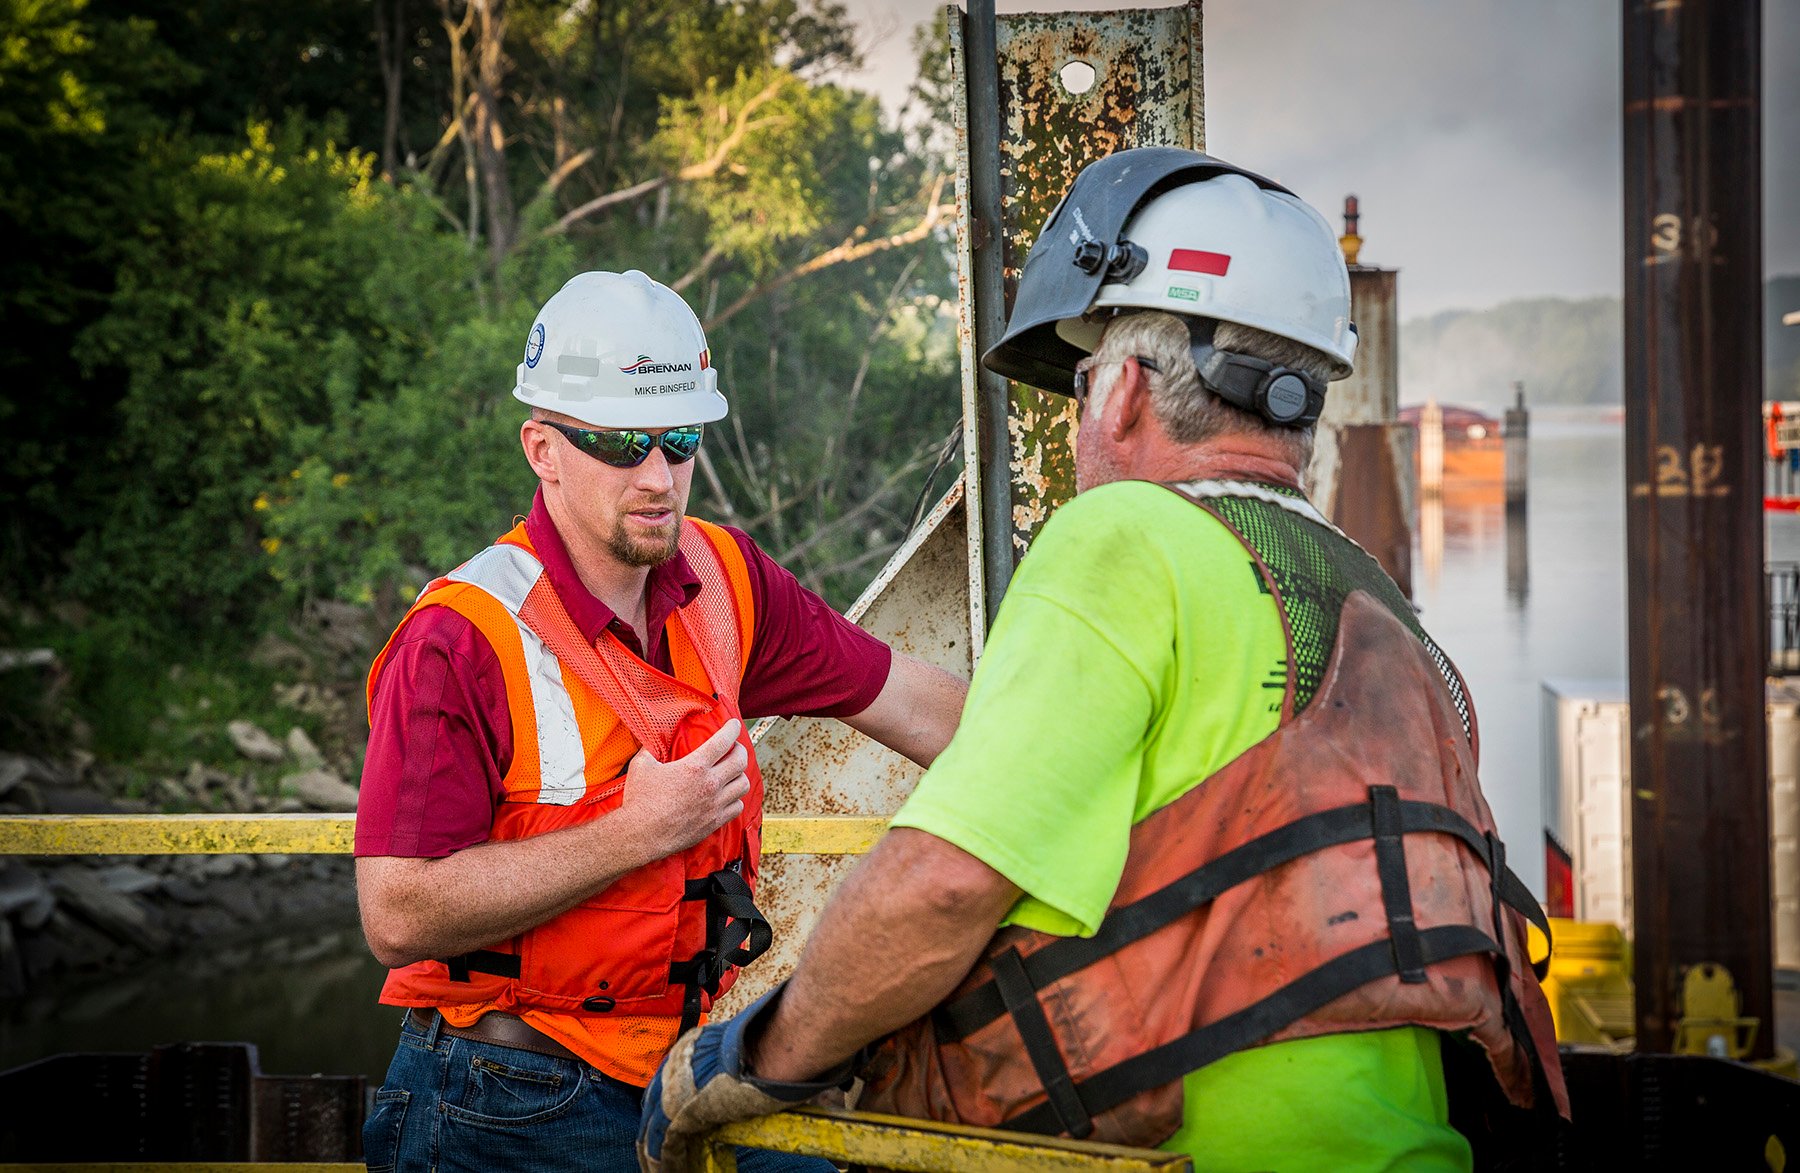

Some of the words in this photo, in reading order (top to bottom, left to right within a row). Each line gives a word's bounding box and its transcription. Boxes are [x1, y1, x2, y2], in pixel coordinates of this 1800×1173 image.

[1168, 287, 1199, 301] MSA
[638, 363, 692, 374] BRENNAN
[634, 385, 657, 396] MIKE
[659, 381, 696, 394] BINSFELD
